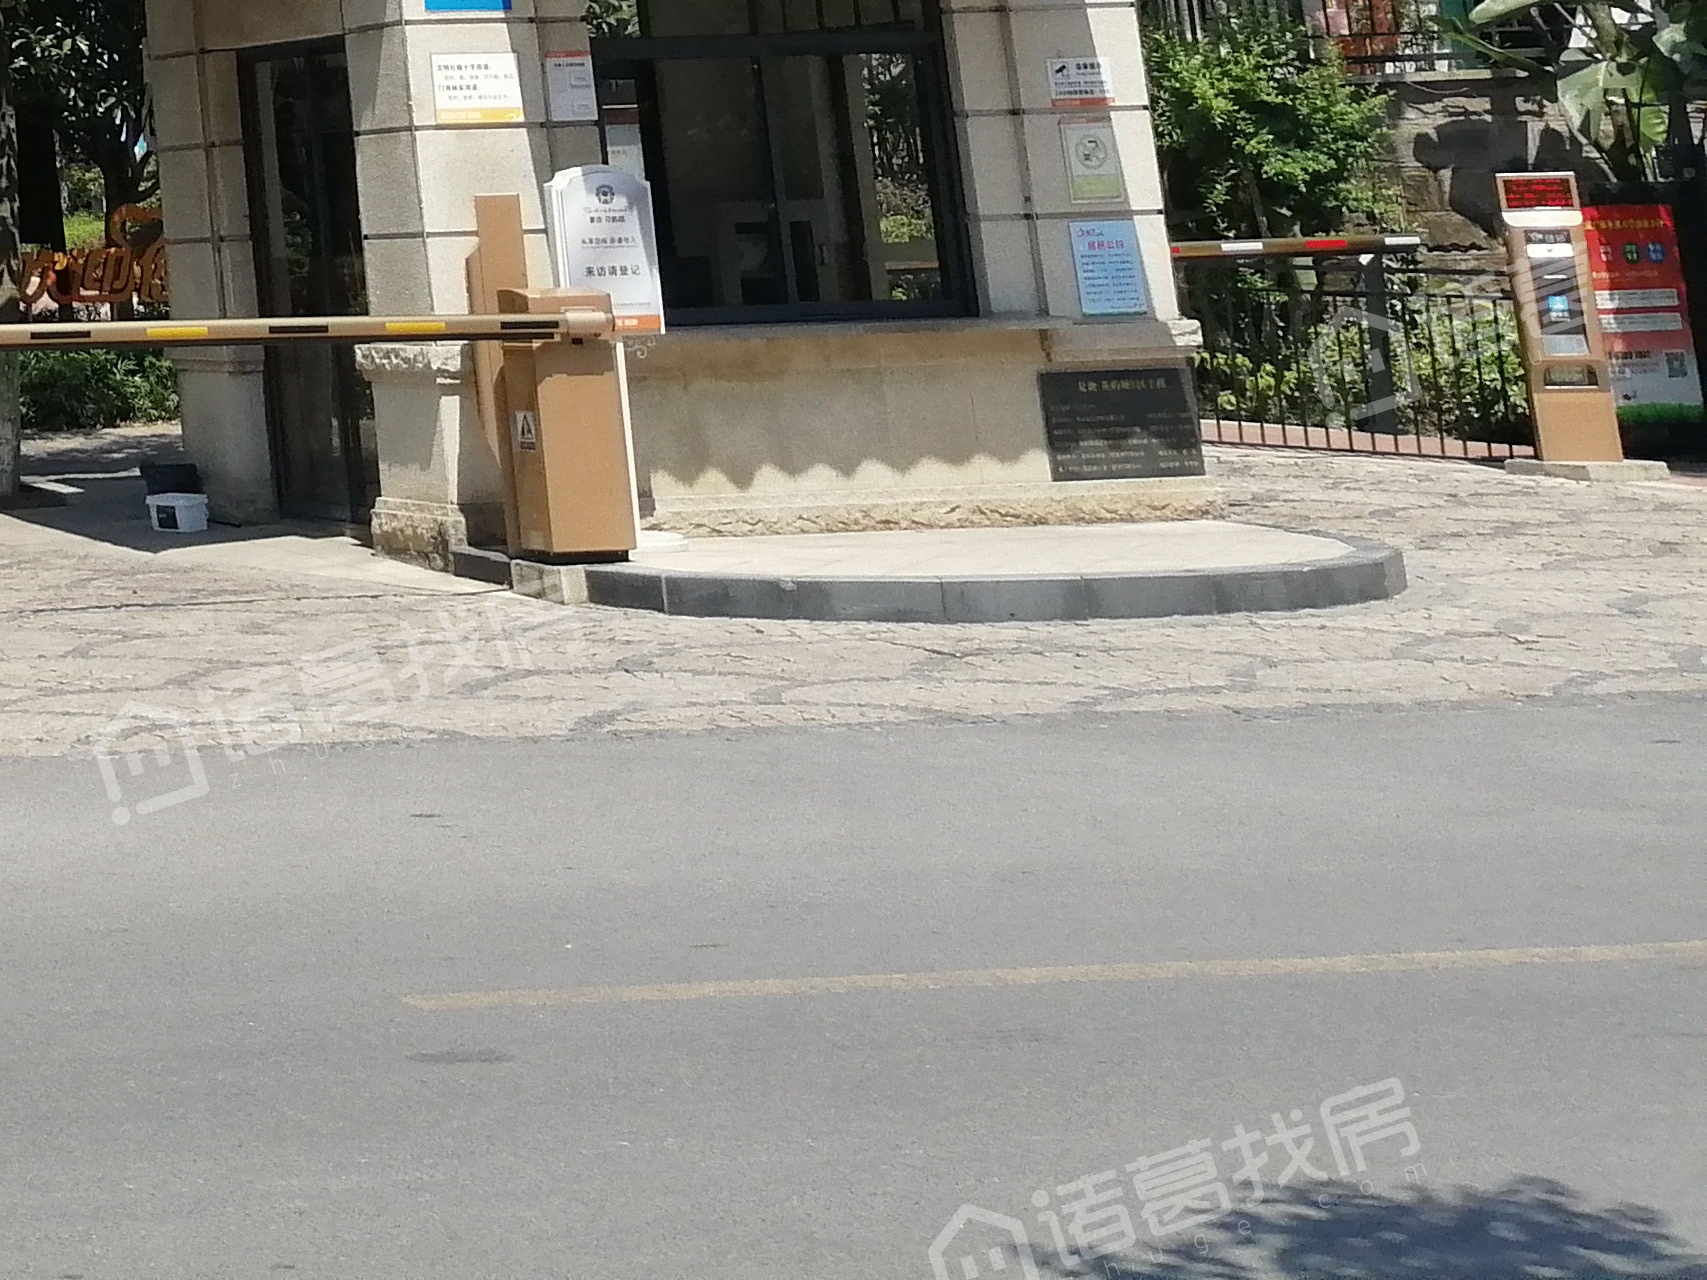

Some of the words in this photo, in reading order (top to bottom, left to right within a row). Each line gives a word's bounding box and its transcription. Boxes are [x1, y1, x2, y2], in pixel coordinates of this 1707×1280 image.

[584, 264, 641, 277] 来访请登记
